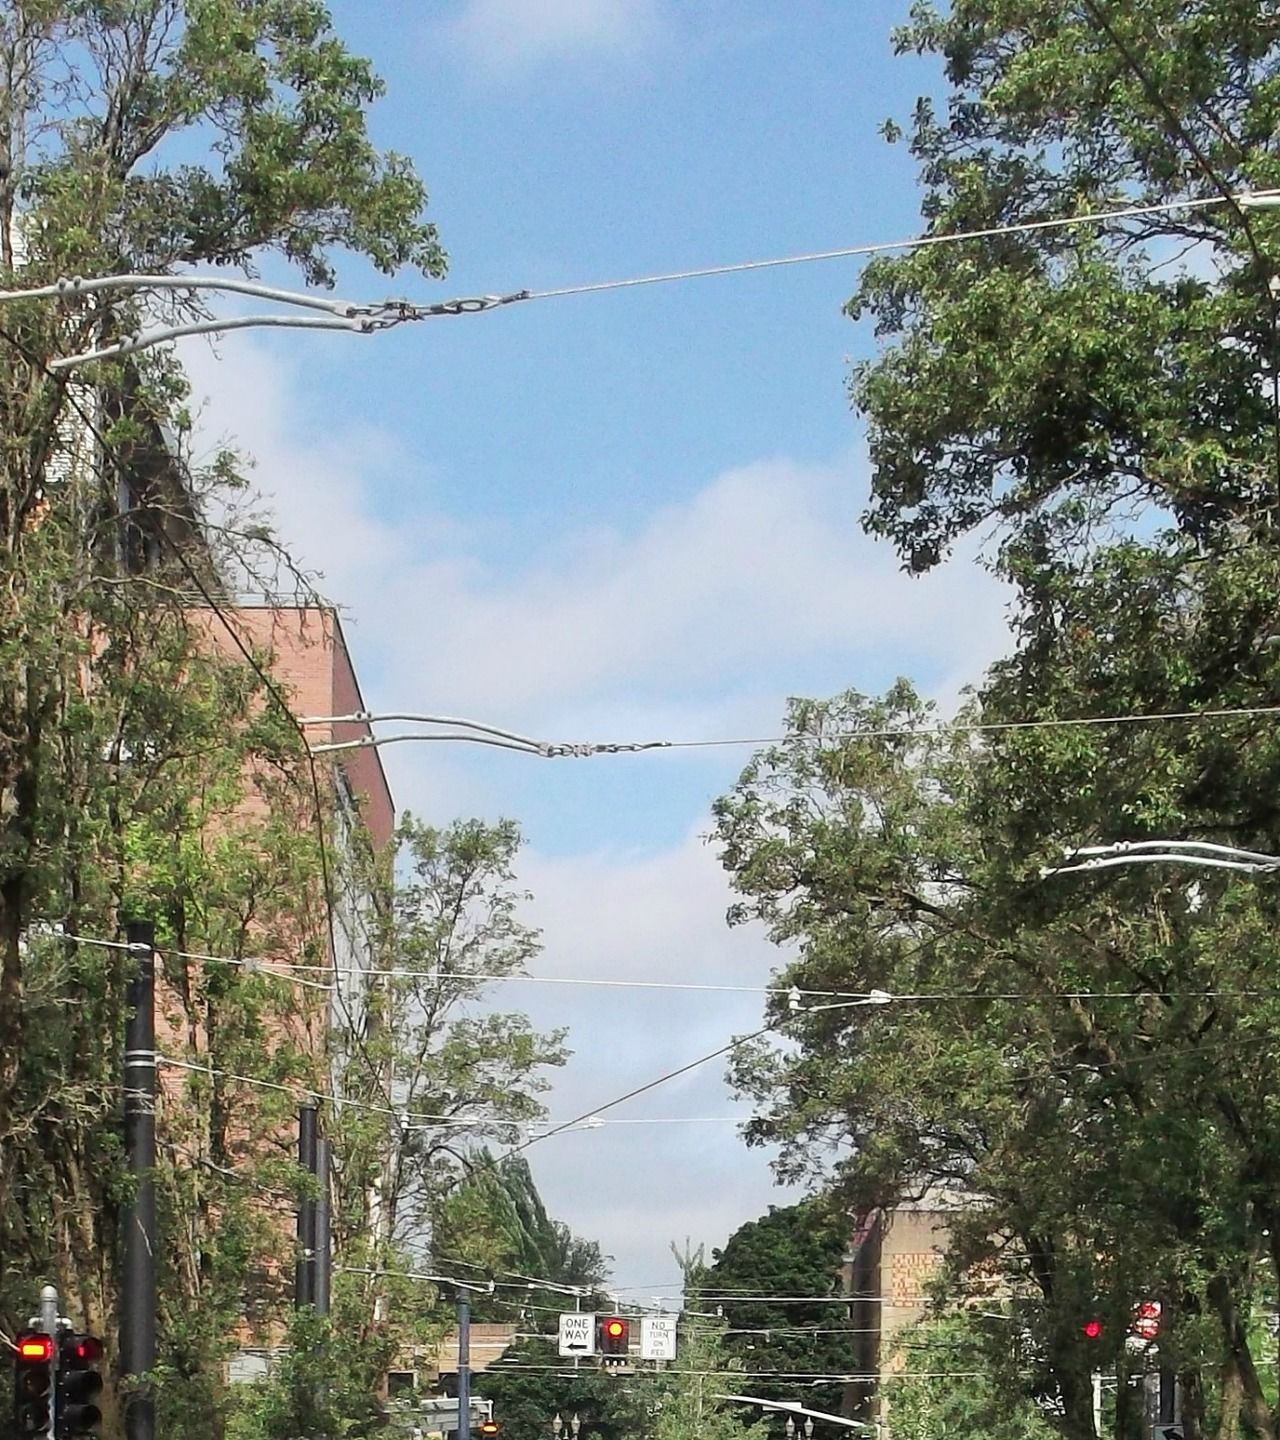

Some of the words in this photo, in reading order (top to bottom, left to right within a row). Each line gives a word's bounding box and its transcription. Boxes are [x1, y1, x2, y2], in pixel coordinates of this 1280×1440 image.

[566, 1319, 588, 1328] ONE
[651, 1322, 666, 1330] NO
[565, 1330, 589, 1340] WAY
[649, 1331, 669, 1339] TURN
